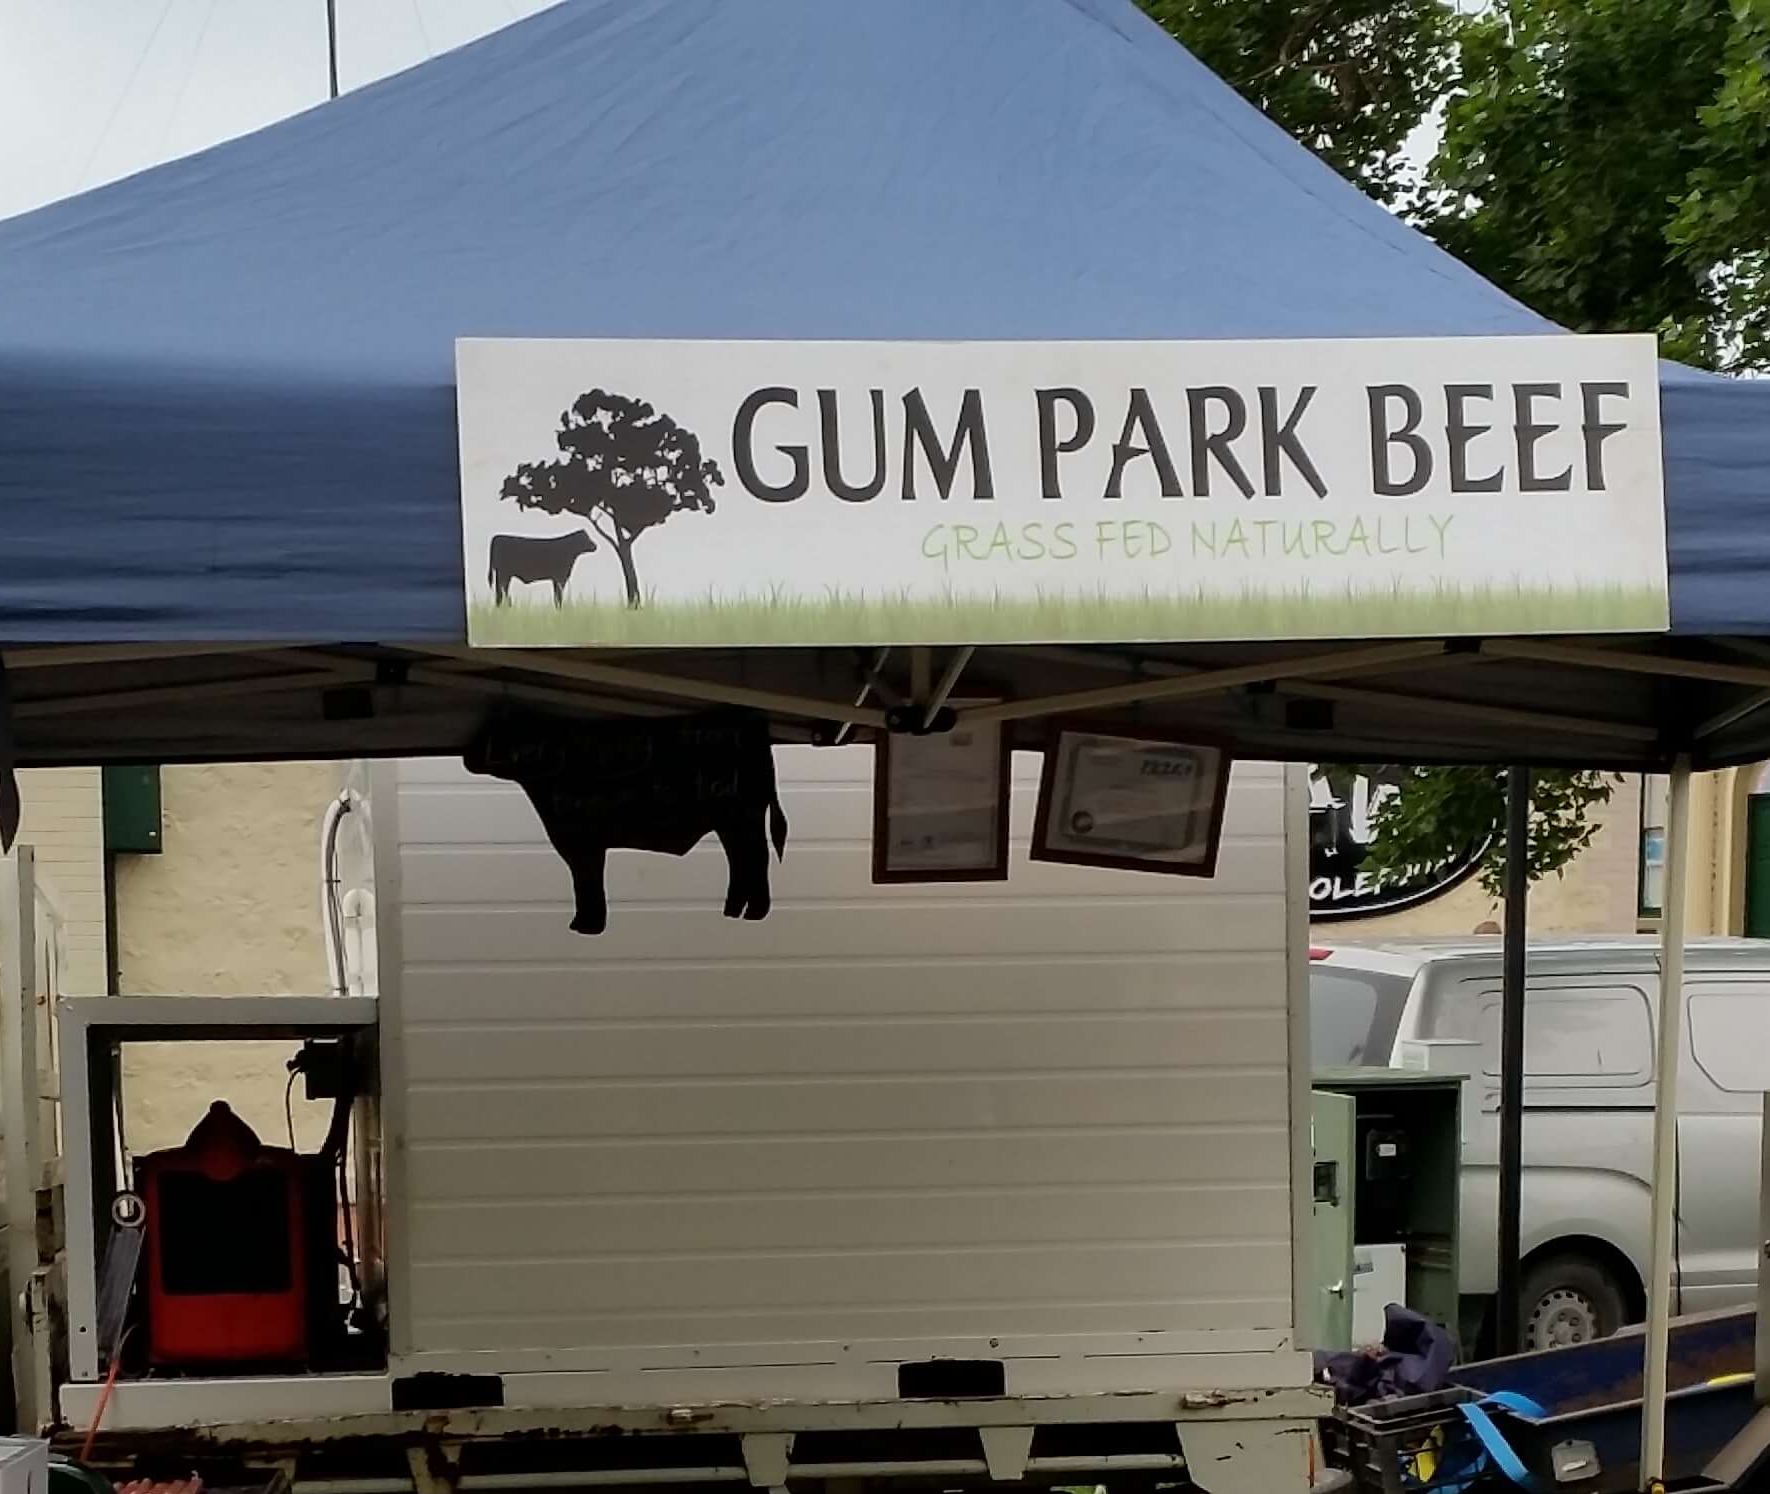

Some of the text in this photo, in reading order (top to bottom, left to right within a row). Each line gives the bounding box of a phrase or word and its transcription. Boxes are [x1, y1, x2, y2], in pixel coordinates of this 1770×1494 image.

[730, 381, 1631, 504] GUM PARK BEEF
[920, 513, 1456, 566] GRASS FED NATURALLY
